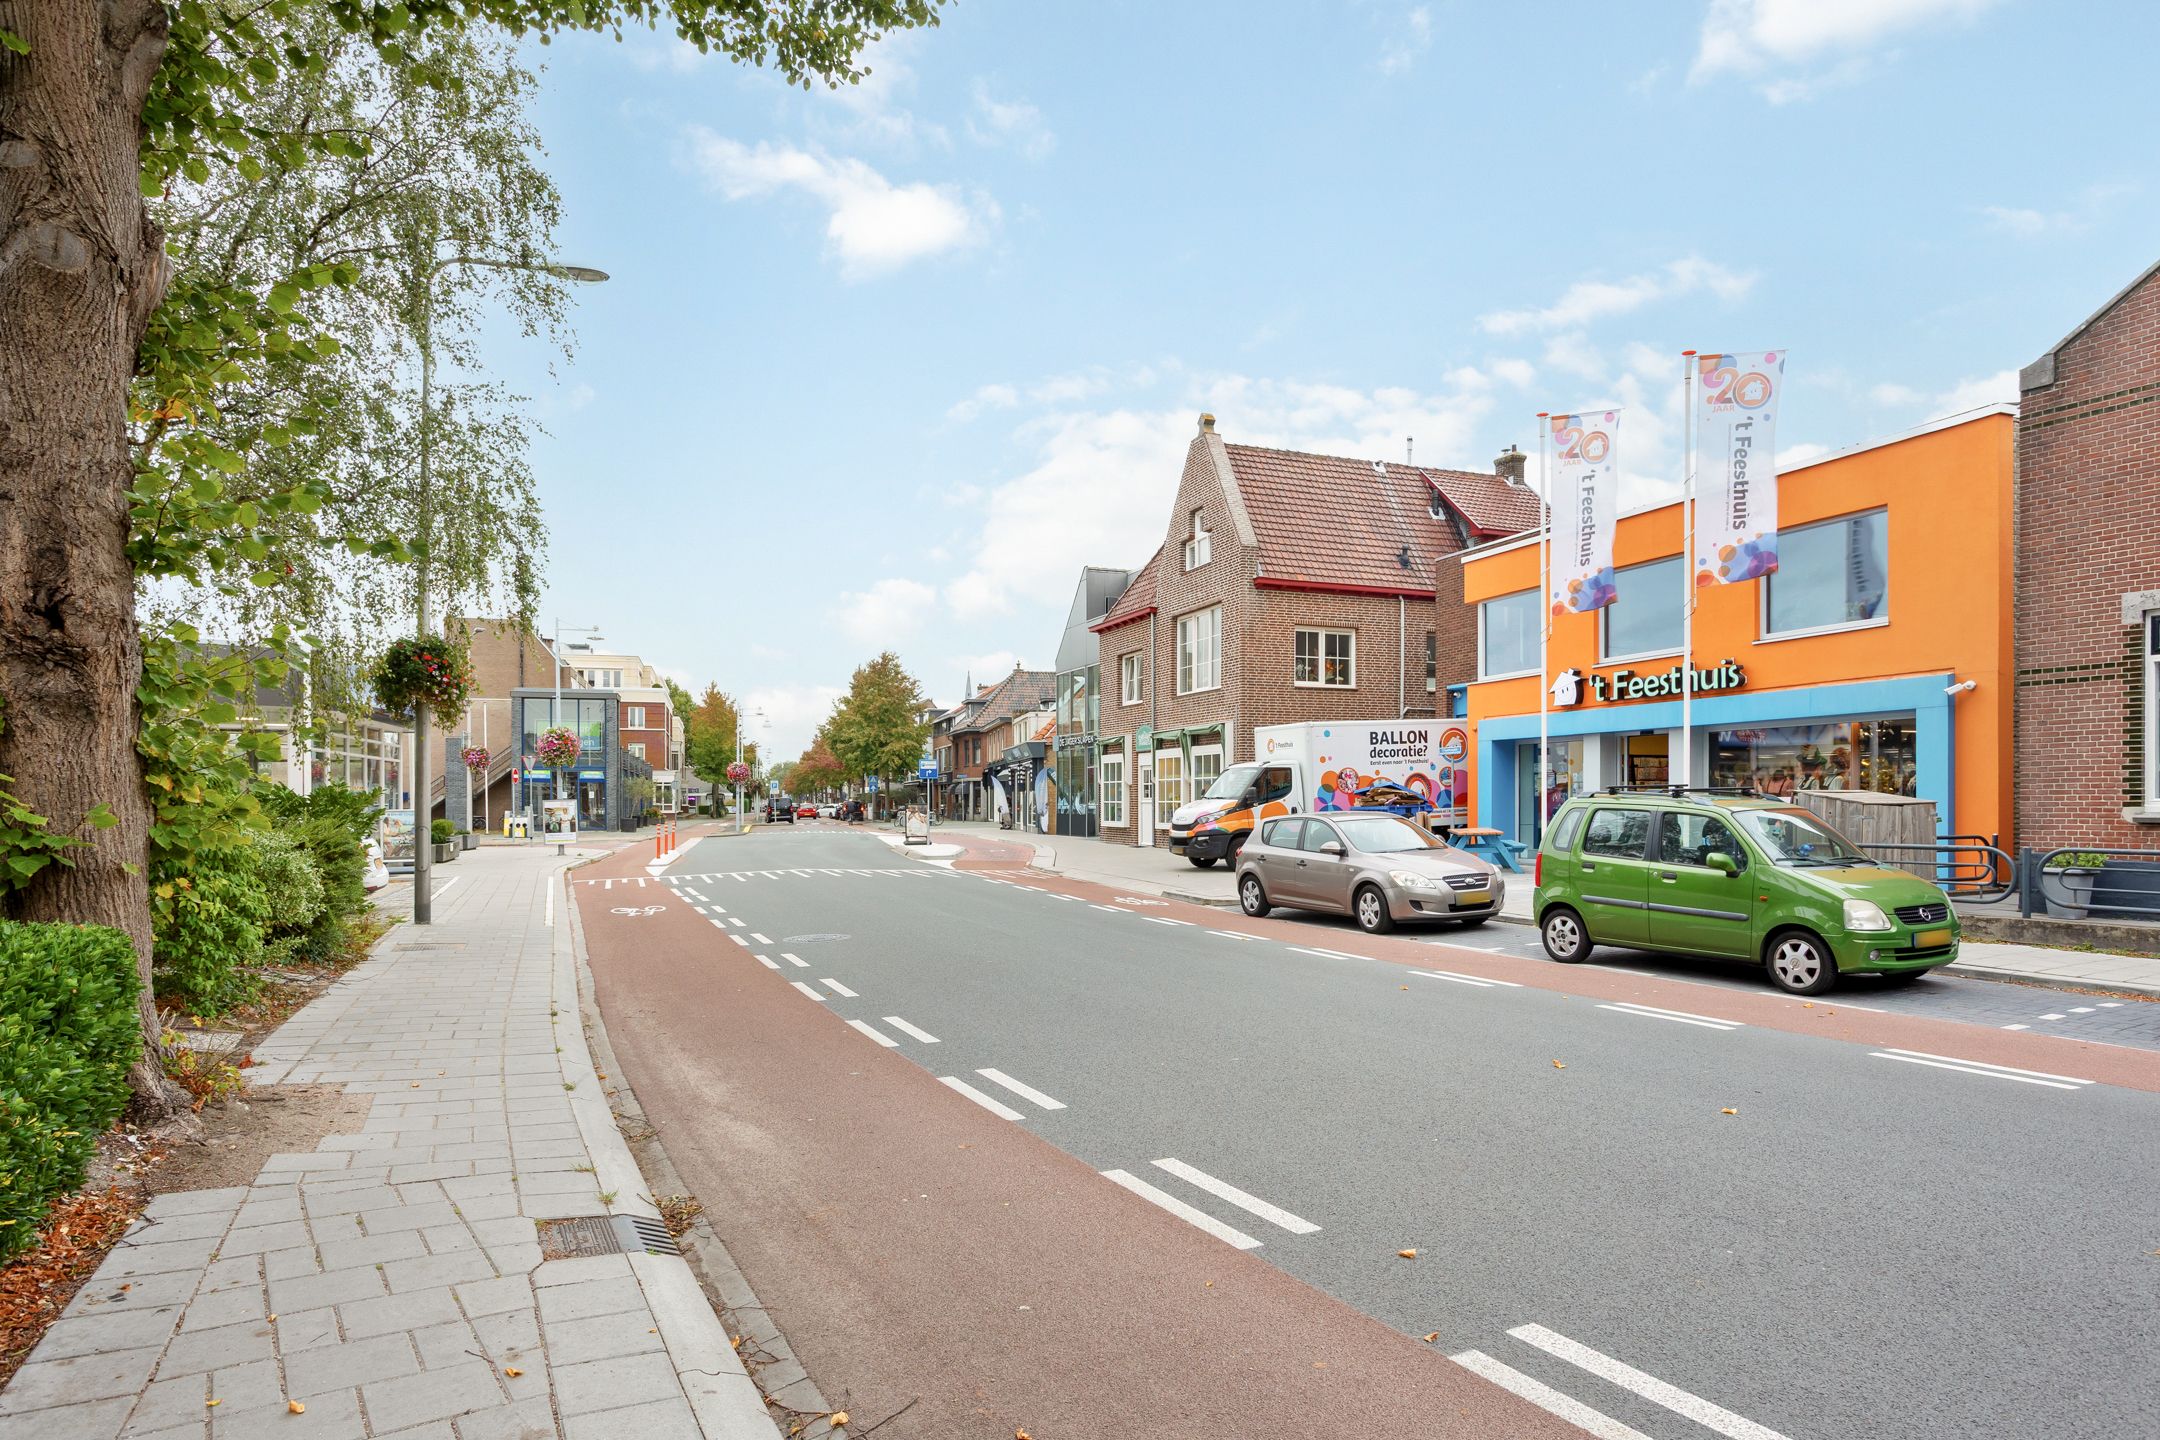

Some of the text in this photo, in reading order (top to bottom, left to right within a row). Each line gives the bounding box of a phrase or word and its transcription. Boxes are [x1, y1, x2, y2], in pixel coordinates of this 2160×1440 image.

[1712, 405, 1735, 414] JAAR
[1733, 436, 1752, 530] Feesthuis
[1580, 486, 1596, 567] Feesthuis
[1612, 659, 1744, 701] Feesthuis
[1369, 730, 1428, 745] BALLON
[1369, 745, 1428, 758] decoratie?
